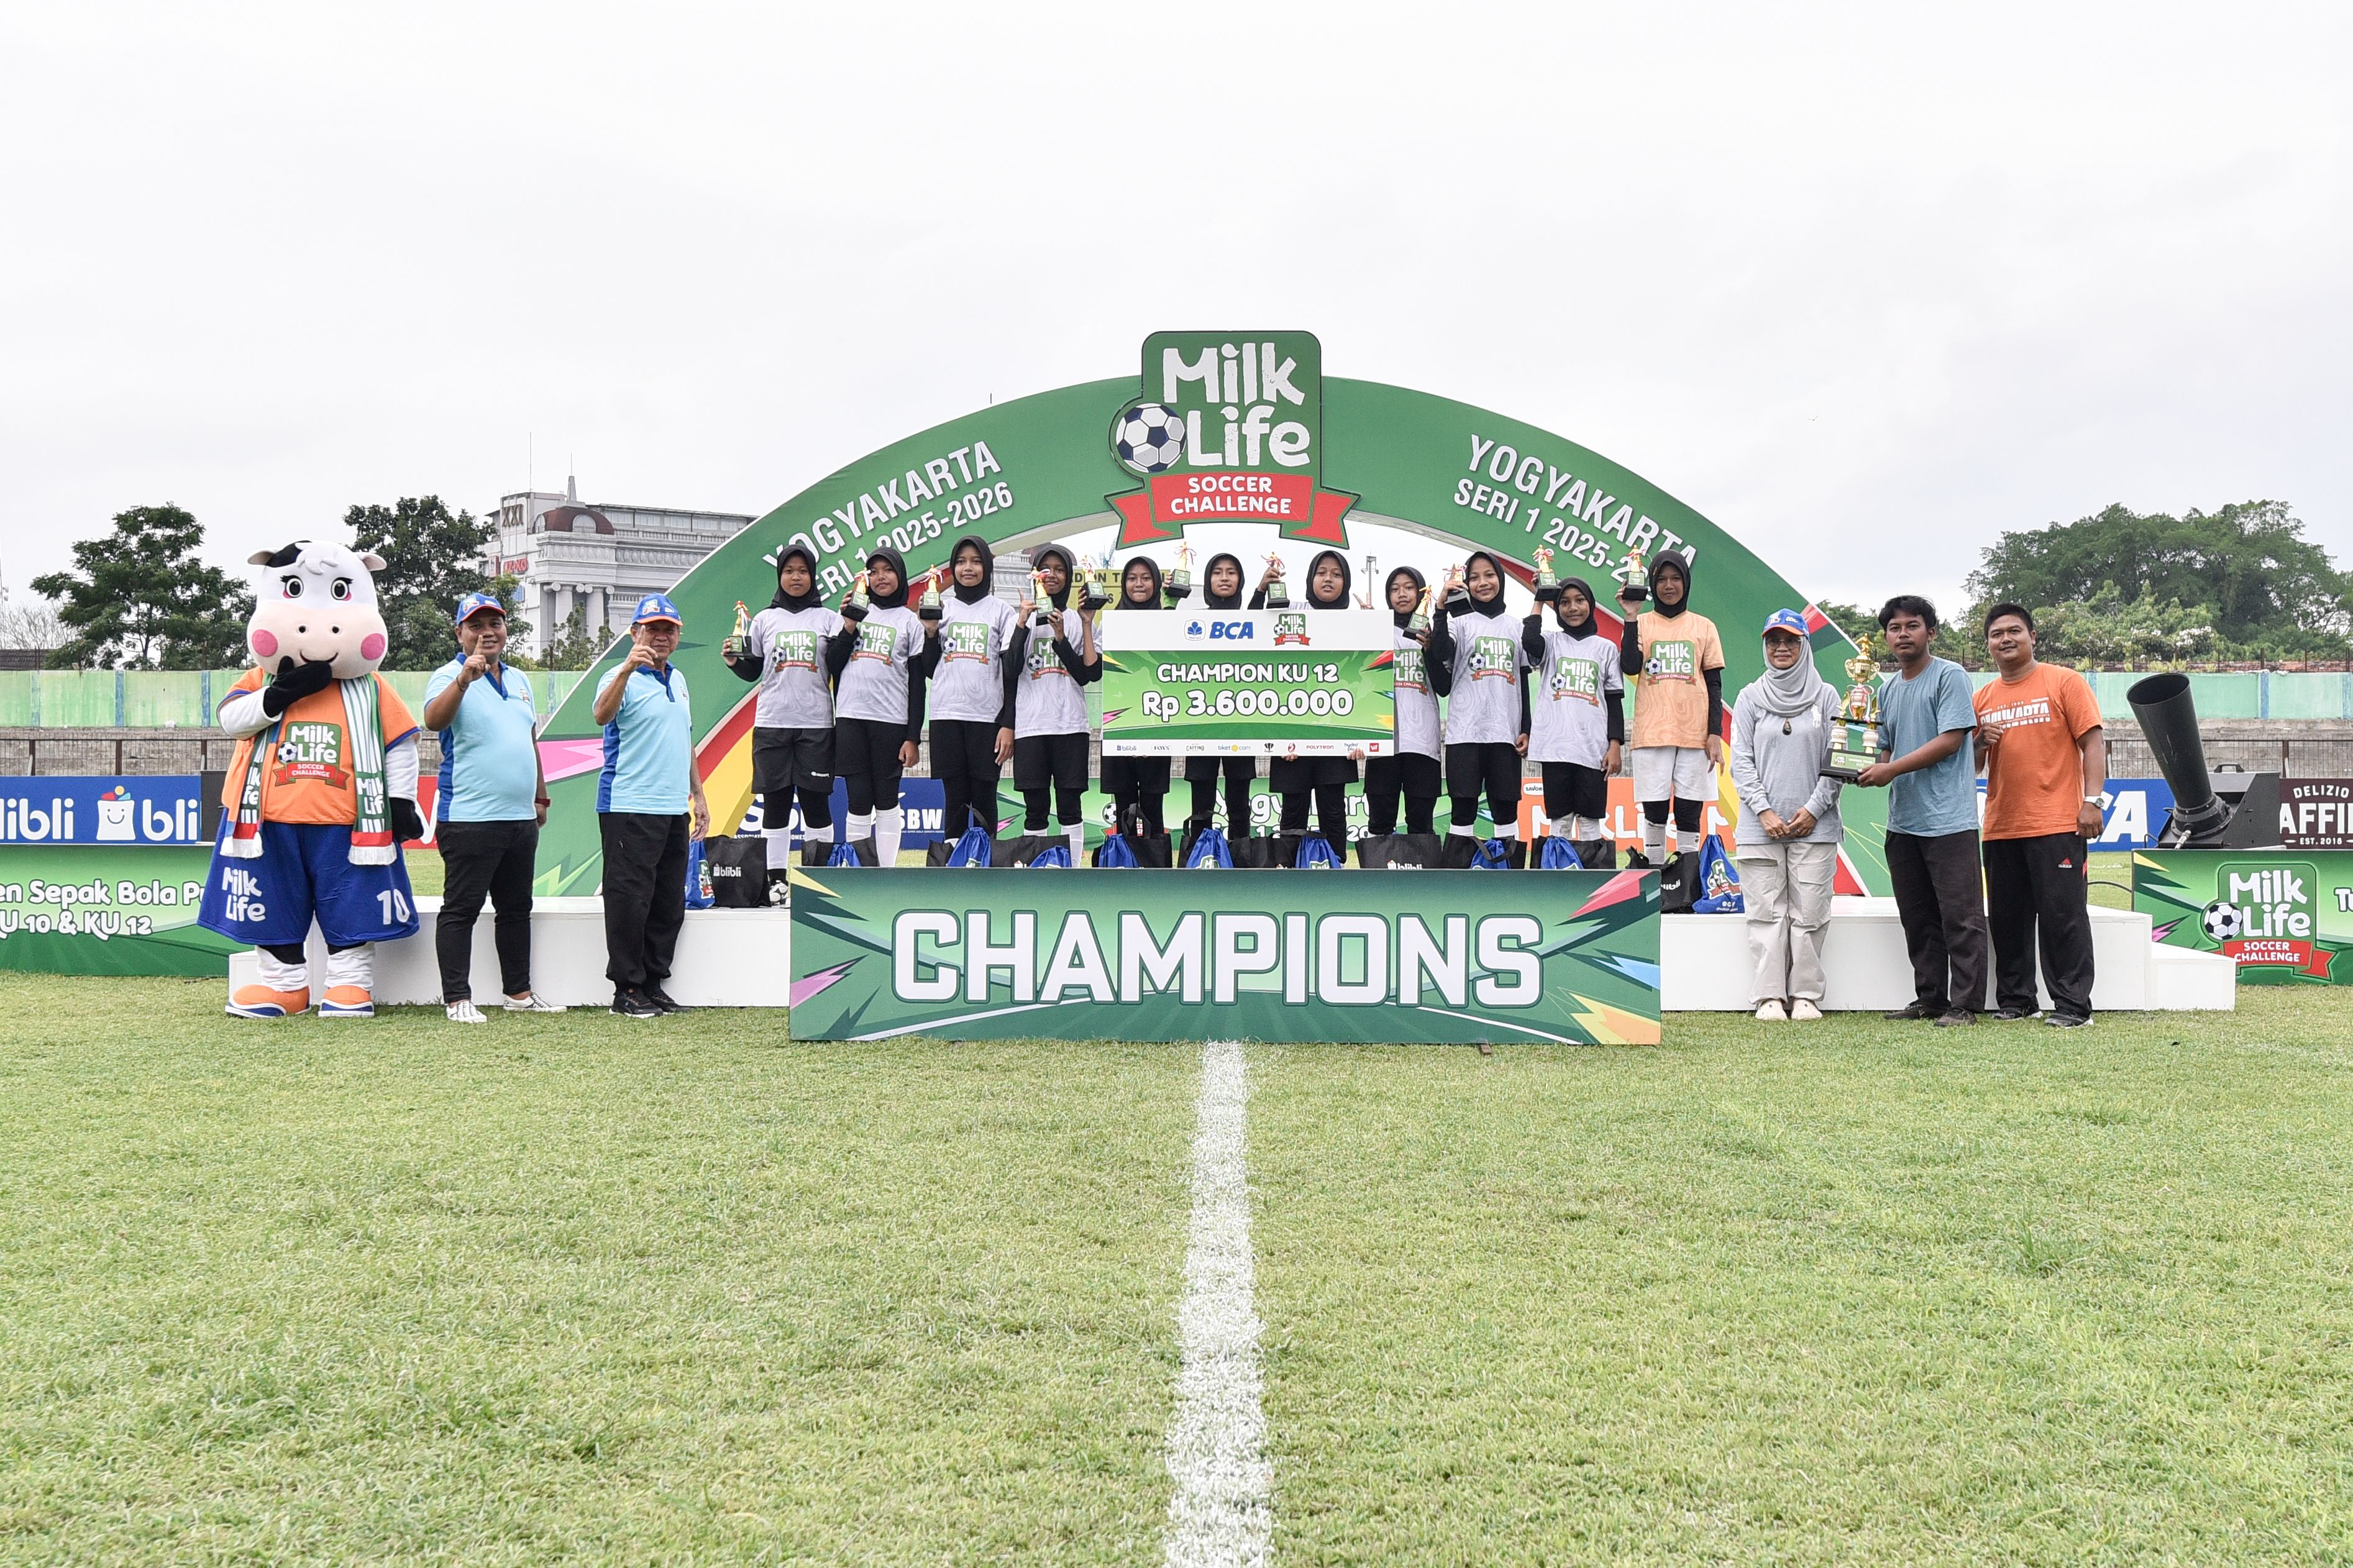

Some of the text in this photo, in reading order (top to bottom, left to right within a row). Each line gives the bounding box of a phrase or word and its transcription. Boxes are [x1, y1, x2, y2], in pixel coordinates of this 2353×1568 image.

[1163, 342, 1305, 406] Milk
[1186, 404, 1311, 467] Life
[1187, 475, 1272, 495] SOCCER
[1170, 496, 1292, 515] CHALLENGE
[1454, 478, 1520, 524] SERI
[1525, 507, 1541, 533] 1
[501, 504, 524, 527] XXI
[816, 559, 855, 602] ERI
[1281, 614, 1304, 626] Milk
[1285, 624, 1304, 634] Life
[780, 632, 813, 647] Milk
[859, 624, 892, 642] Milk
[953, 624, 985, 640] Milk
[1208, 621, 1254, 640] BCA
[786, 646, 814, 661] Life
[862, 638, 890, 655] Life
[956, 638, 985, 654] Life
[1038, 640, 1055, 655] Mi
[1480, 639, 1512, 657] Milk
[1655, 643, 1691, 659] Milk
[1393, 650, 1423, 667] Milk
[1485, 654, 1513, 672] Life
[1661, 658, 1692, 674] Life
[1156, 663, 1340, 683] CHAMPION KU 12
[1396, 666, 1424, 683] Life
[1561, 660, 1596, 680] Milk
[1565, 675, 1596, 695] Life
[1142, 688, 1355, 722] Rp 3.600.000
[291, 725, 336, 745] Milk
[297, 742, 337, 763] Life
[291, 770, 331, 778] CHALLENGE
[2293, 785, 2350, 799] DELIZIO
[363, 795, 385, 815] Lif
[2279, 803, 2353, 834] AFFI
[720, 866, 742, 877] blibli
[222, 867, 262, 898] Milk
[2229, 870, 2308, 905] Milk
[28, 878, 112, 910] Sepak
[117, 880, 178, 906] Bola
[225, 894, 267, 922] Life
[377, 888, 411, 925] 10
[0, 909, 153, 941] U 10 & KU 12
[2242, 903, 2311, 937] Life
[2243, 941, 2290, 951] SOCCER
[892, 908, 1543, 1008] CHAMPIONS
[2233, 952, 2301, 962] CHALLENGE
